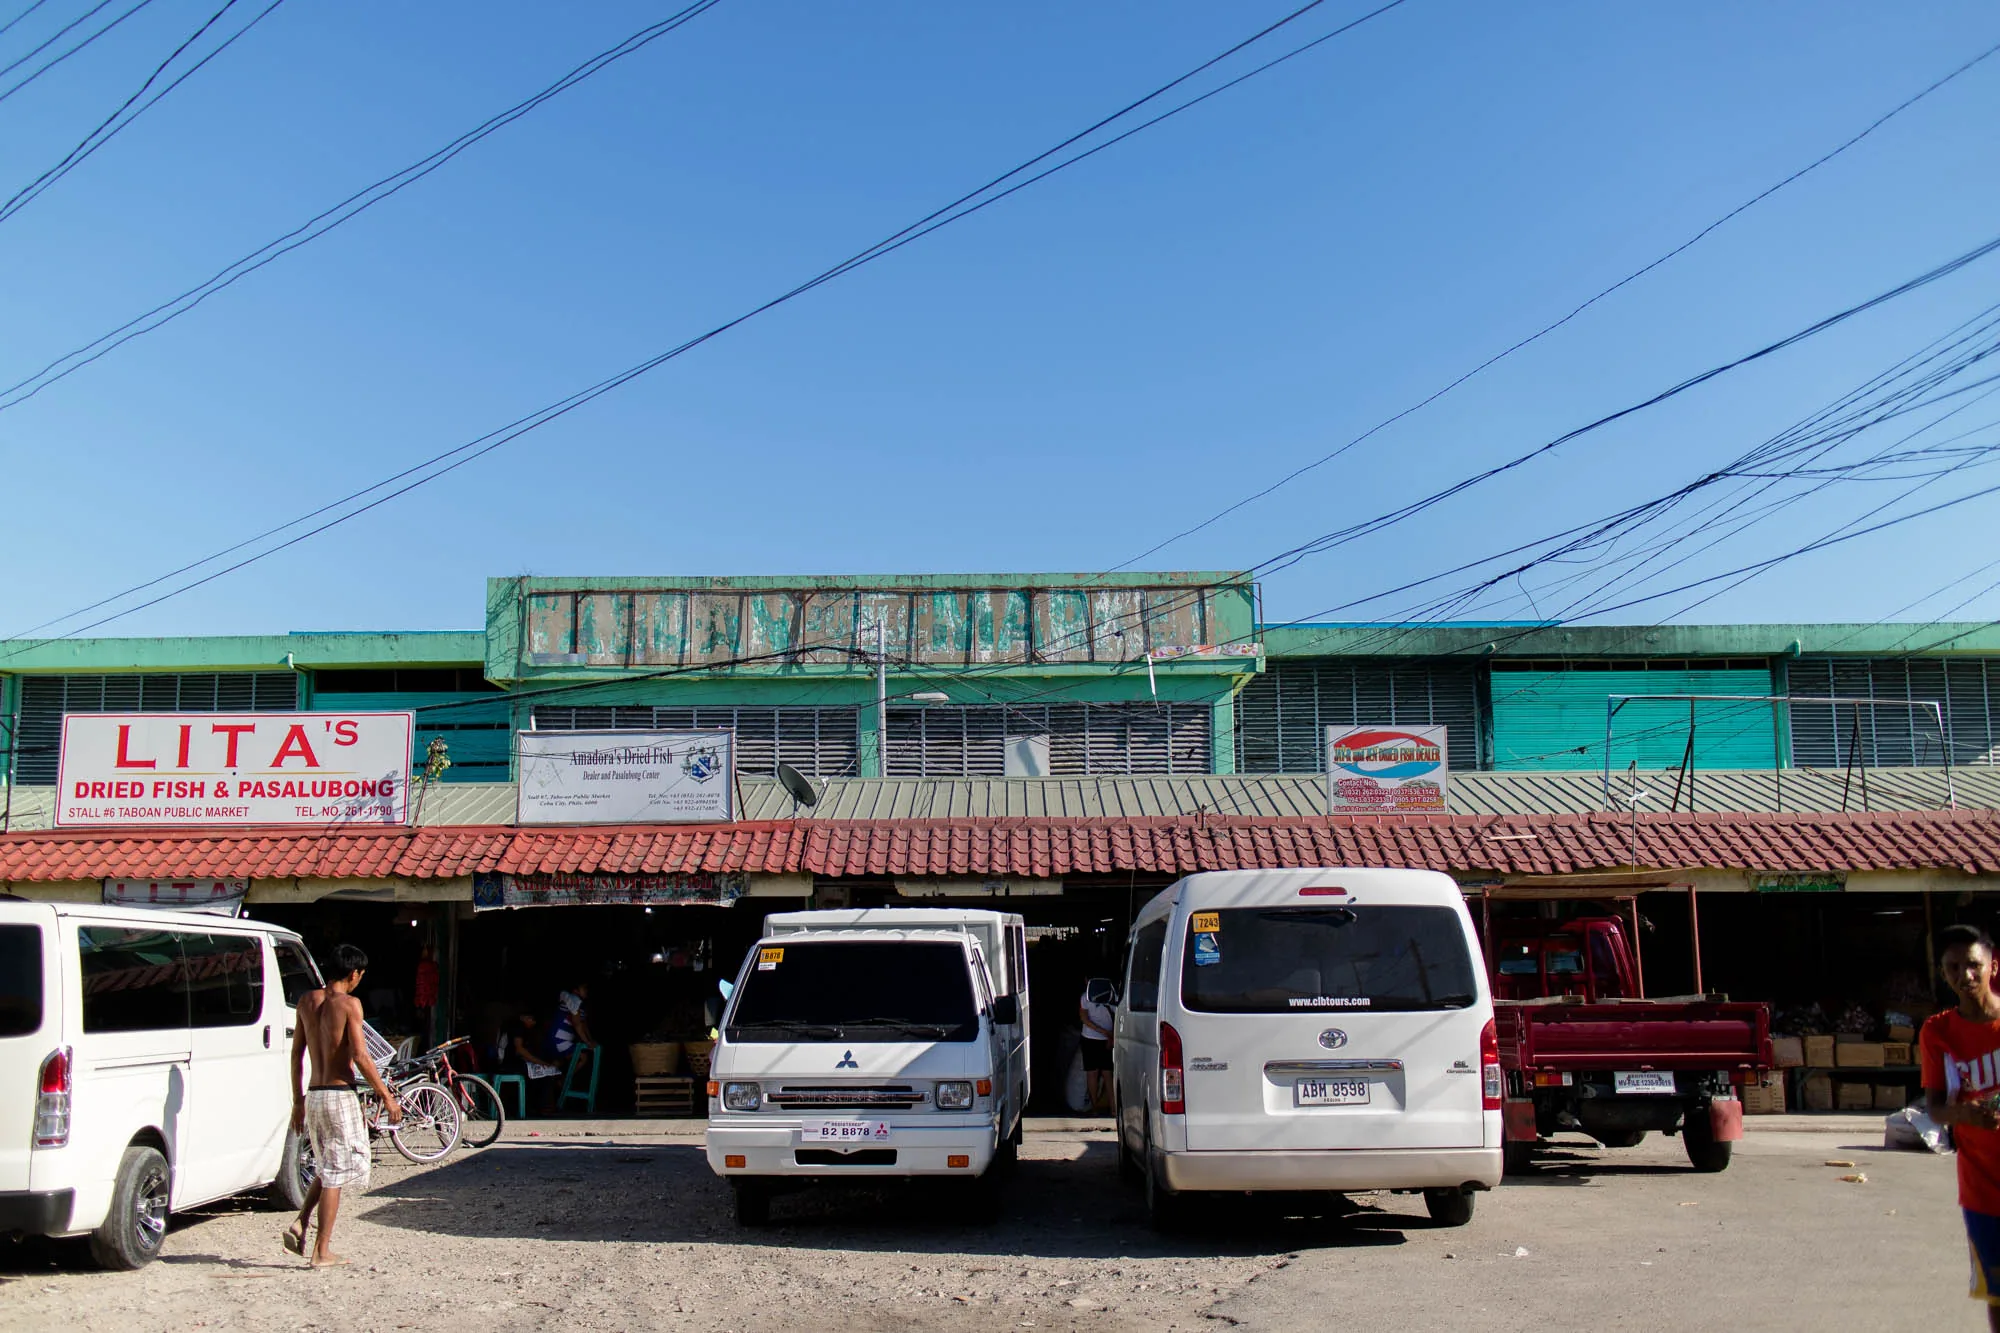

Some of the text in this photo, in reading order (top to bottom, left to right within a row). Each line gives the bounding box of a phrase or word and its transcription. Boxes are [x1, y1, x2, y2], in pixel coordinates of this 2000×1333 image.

[114, 720, 360, 770] LITA'S
[570, 747, 673, 765] Amadora's Dried Fish
[583, 770, 661, 781] Dealer and Pasalubong Center
[75, 780, 395, 799] DRIED FISH & PASALUBONG
[68, 805, 393, 818] STALL #6 TABOAN PUBLIC MARKET TEL. NO. 261-1790
[116, 882, 244, 902] LITA'S
[1288, 997, 1371, 1006] www.clbtours.com
[1302, 1082, 1366, 1097] ABM 8598
[822, 1127, 870, 1136] B2 B878
